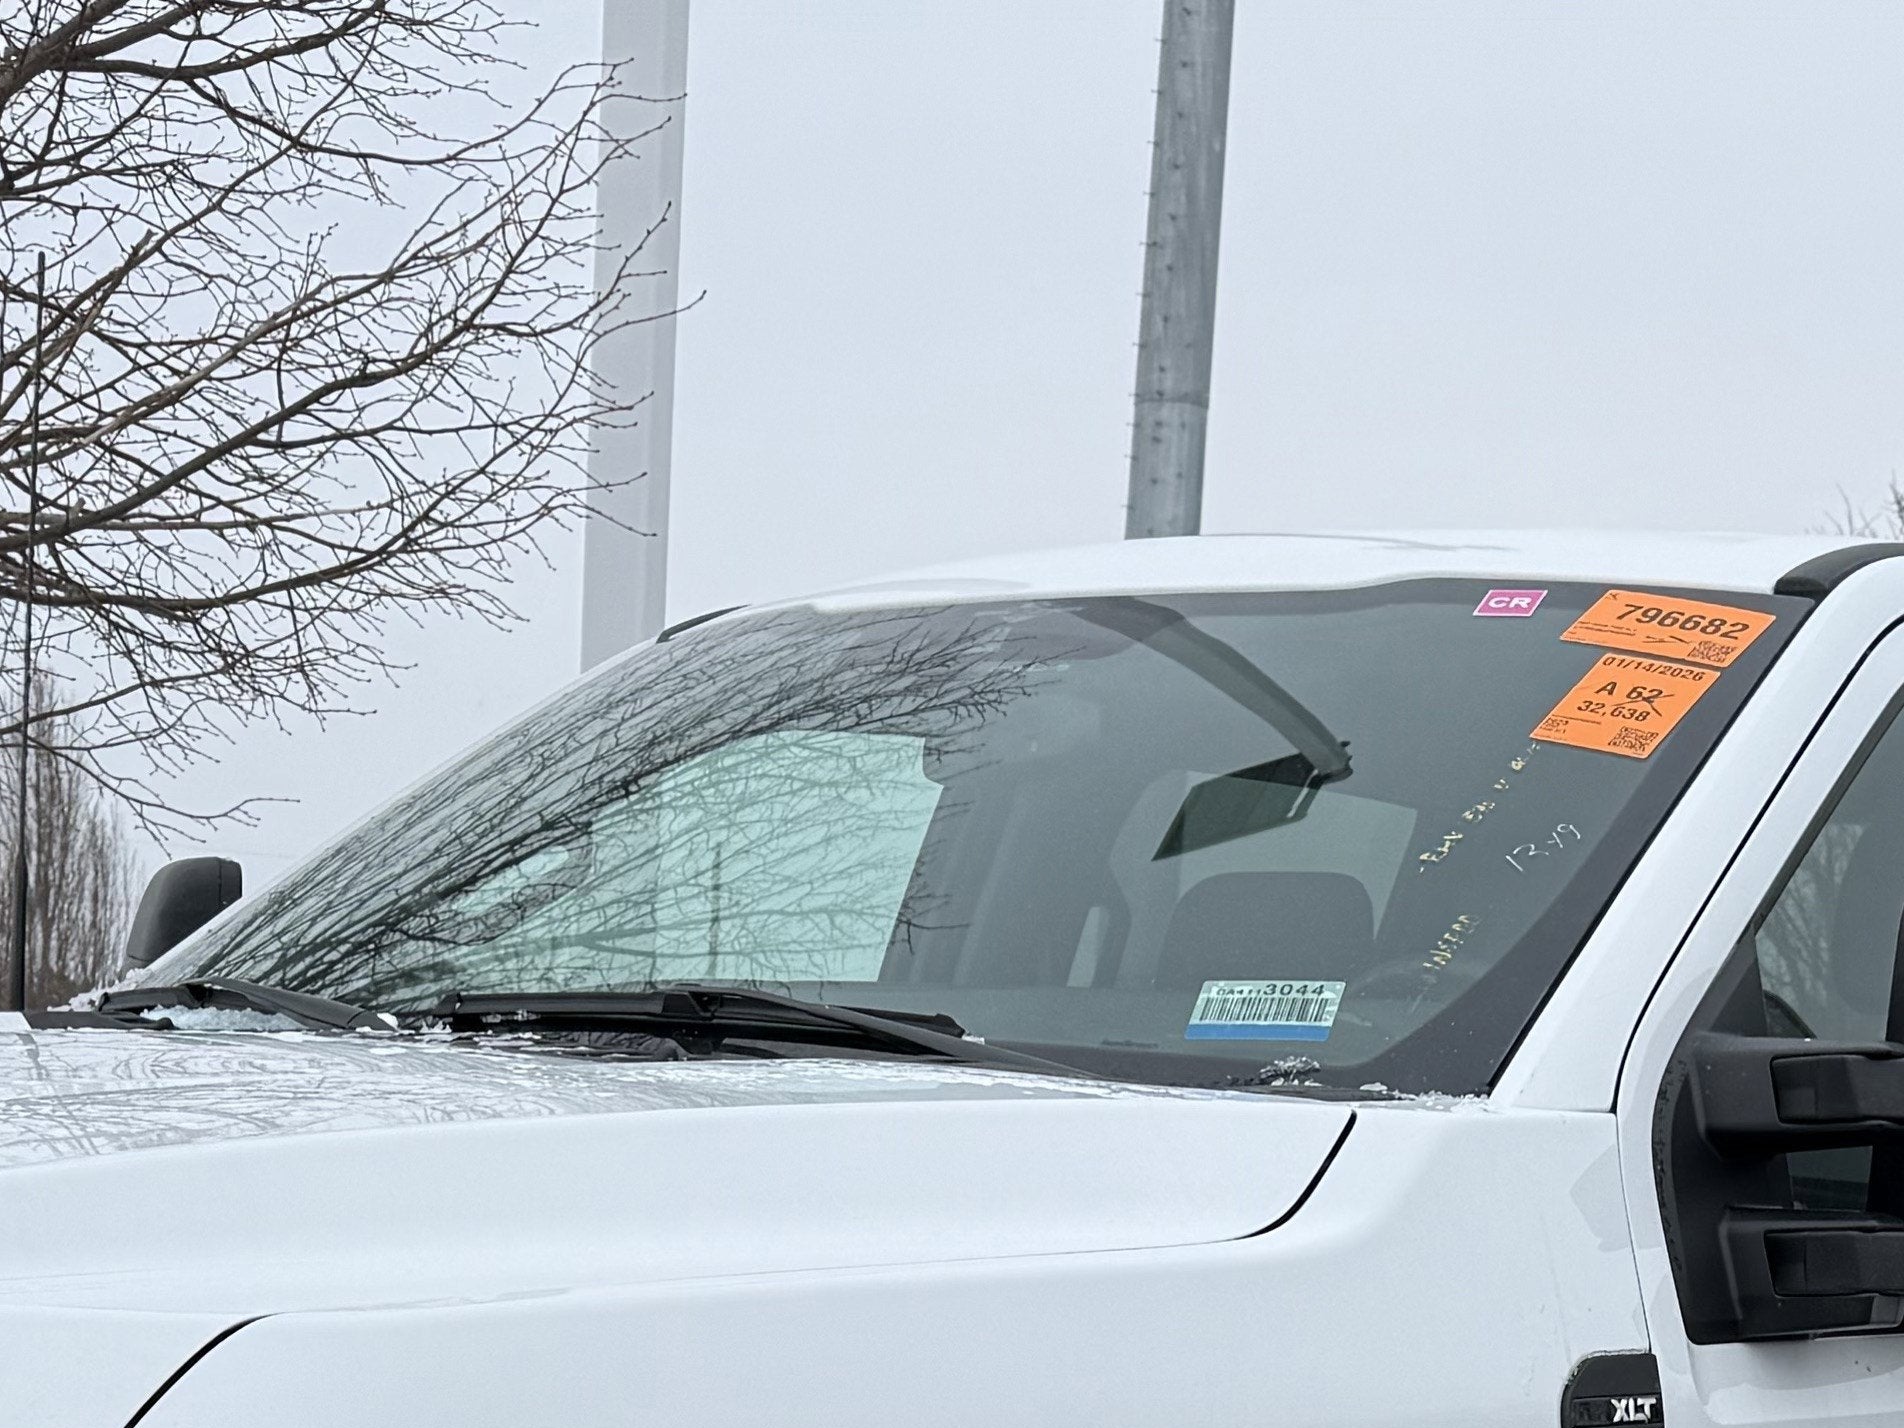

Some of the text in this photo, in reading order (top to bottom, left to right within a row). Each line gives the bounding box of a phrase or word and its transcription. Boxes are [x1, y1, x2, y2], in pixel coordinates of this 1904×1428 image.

[1488, 596, 1533, 609] CR
[1616, 604, 1749, 640] 796682
[1602, 656, 1706, 682] 01/14/2026
[1594, 681, 1618, 696] A
[1576, 700, 1651, 722] 32,638
[1611, 1397, 1656, 1424] XLT
